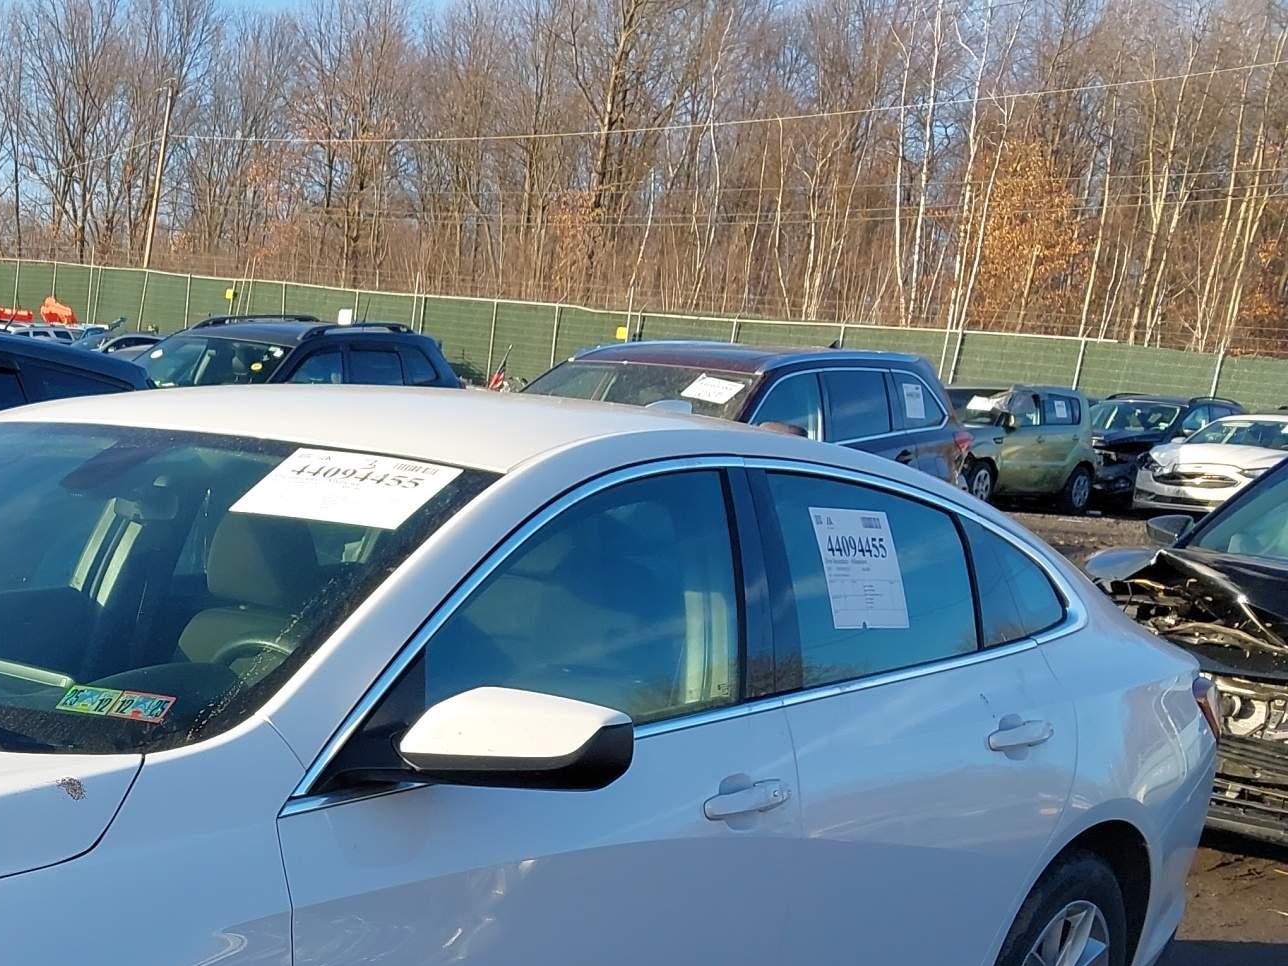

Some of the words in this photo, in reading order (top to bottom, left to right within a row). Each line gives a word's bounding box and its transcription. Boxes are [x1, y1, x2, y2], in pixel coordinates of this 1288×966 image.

[291, 463, 425, 489] 44094455
[827, 535, 888, 558] 44094455
[94, 698, 113, 713] 12
[115, 699, 135, 714] 12
